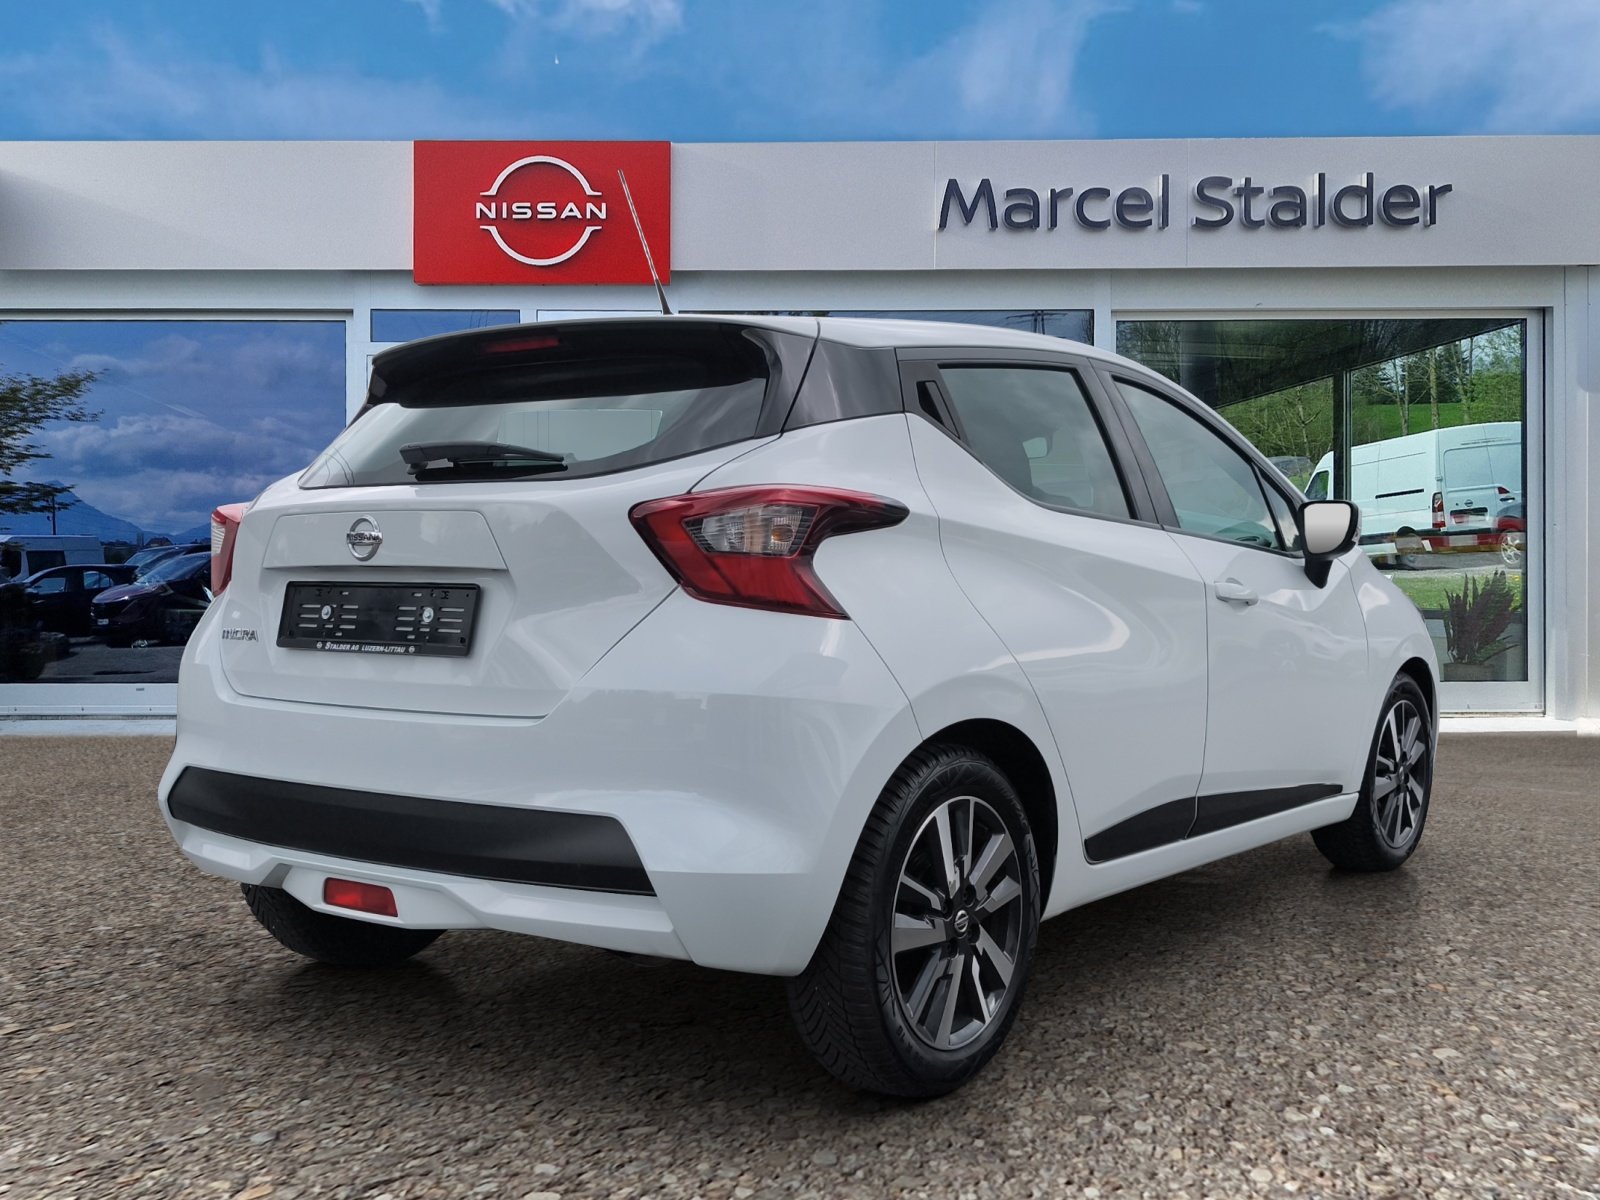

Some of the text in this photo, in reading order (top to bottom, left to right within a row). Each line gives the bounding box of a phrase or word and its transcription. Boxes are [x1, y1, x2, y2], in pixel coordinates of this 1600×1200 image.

[938, 172, 1453, 230] Marcel Stalder
[475, 202, 607, 219] NISSAN
[325, 641, 350, 651] STALDER
